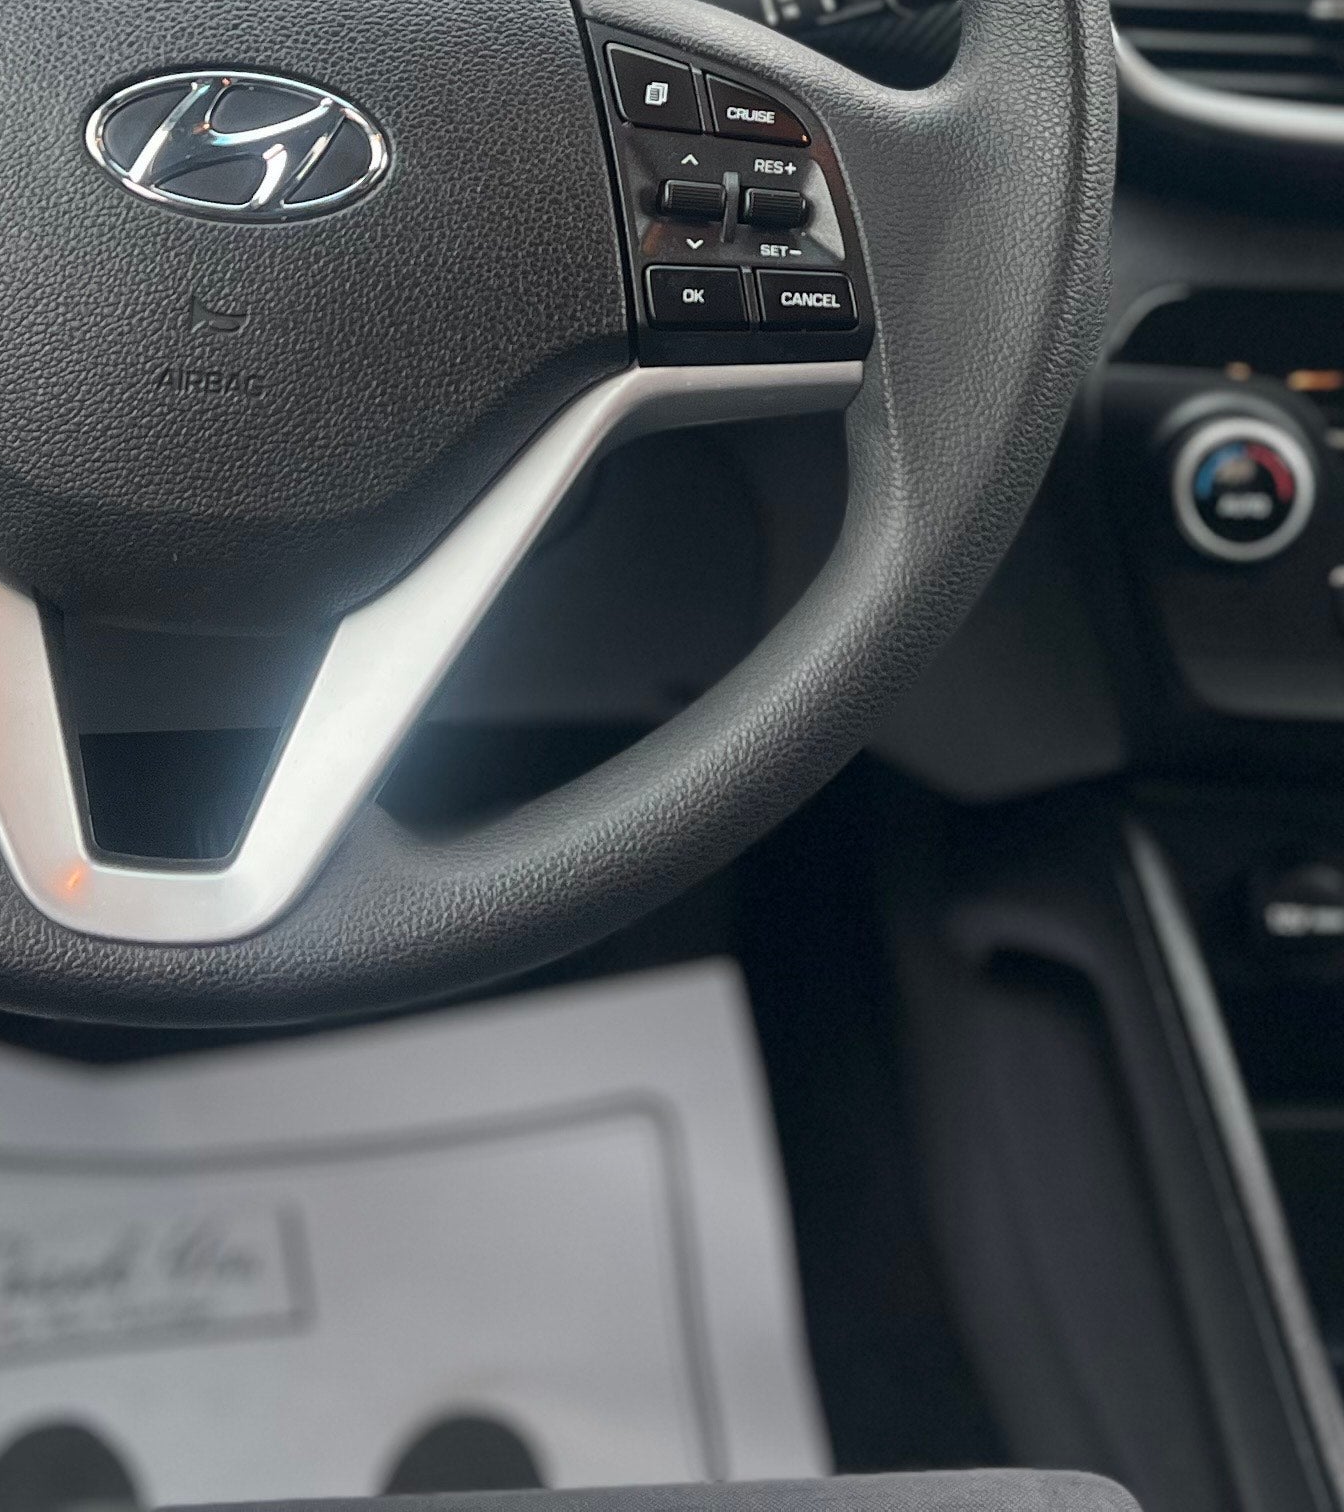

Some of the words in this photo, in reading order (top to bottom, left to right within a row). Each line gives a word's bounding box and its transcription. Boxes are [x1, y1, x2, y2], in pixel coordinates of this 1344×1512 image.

[726, 106, 775, 124] CRUISE
[754, 158, 797, 176] RES+
[682, 288, 705, 304] OK
[781, 291, 841, 309] CANCEL
